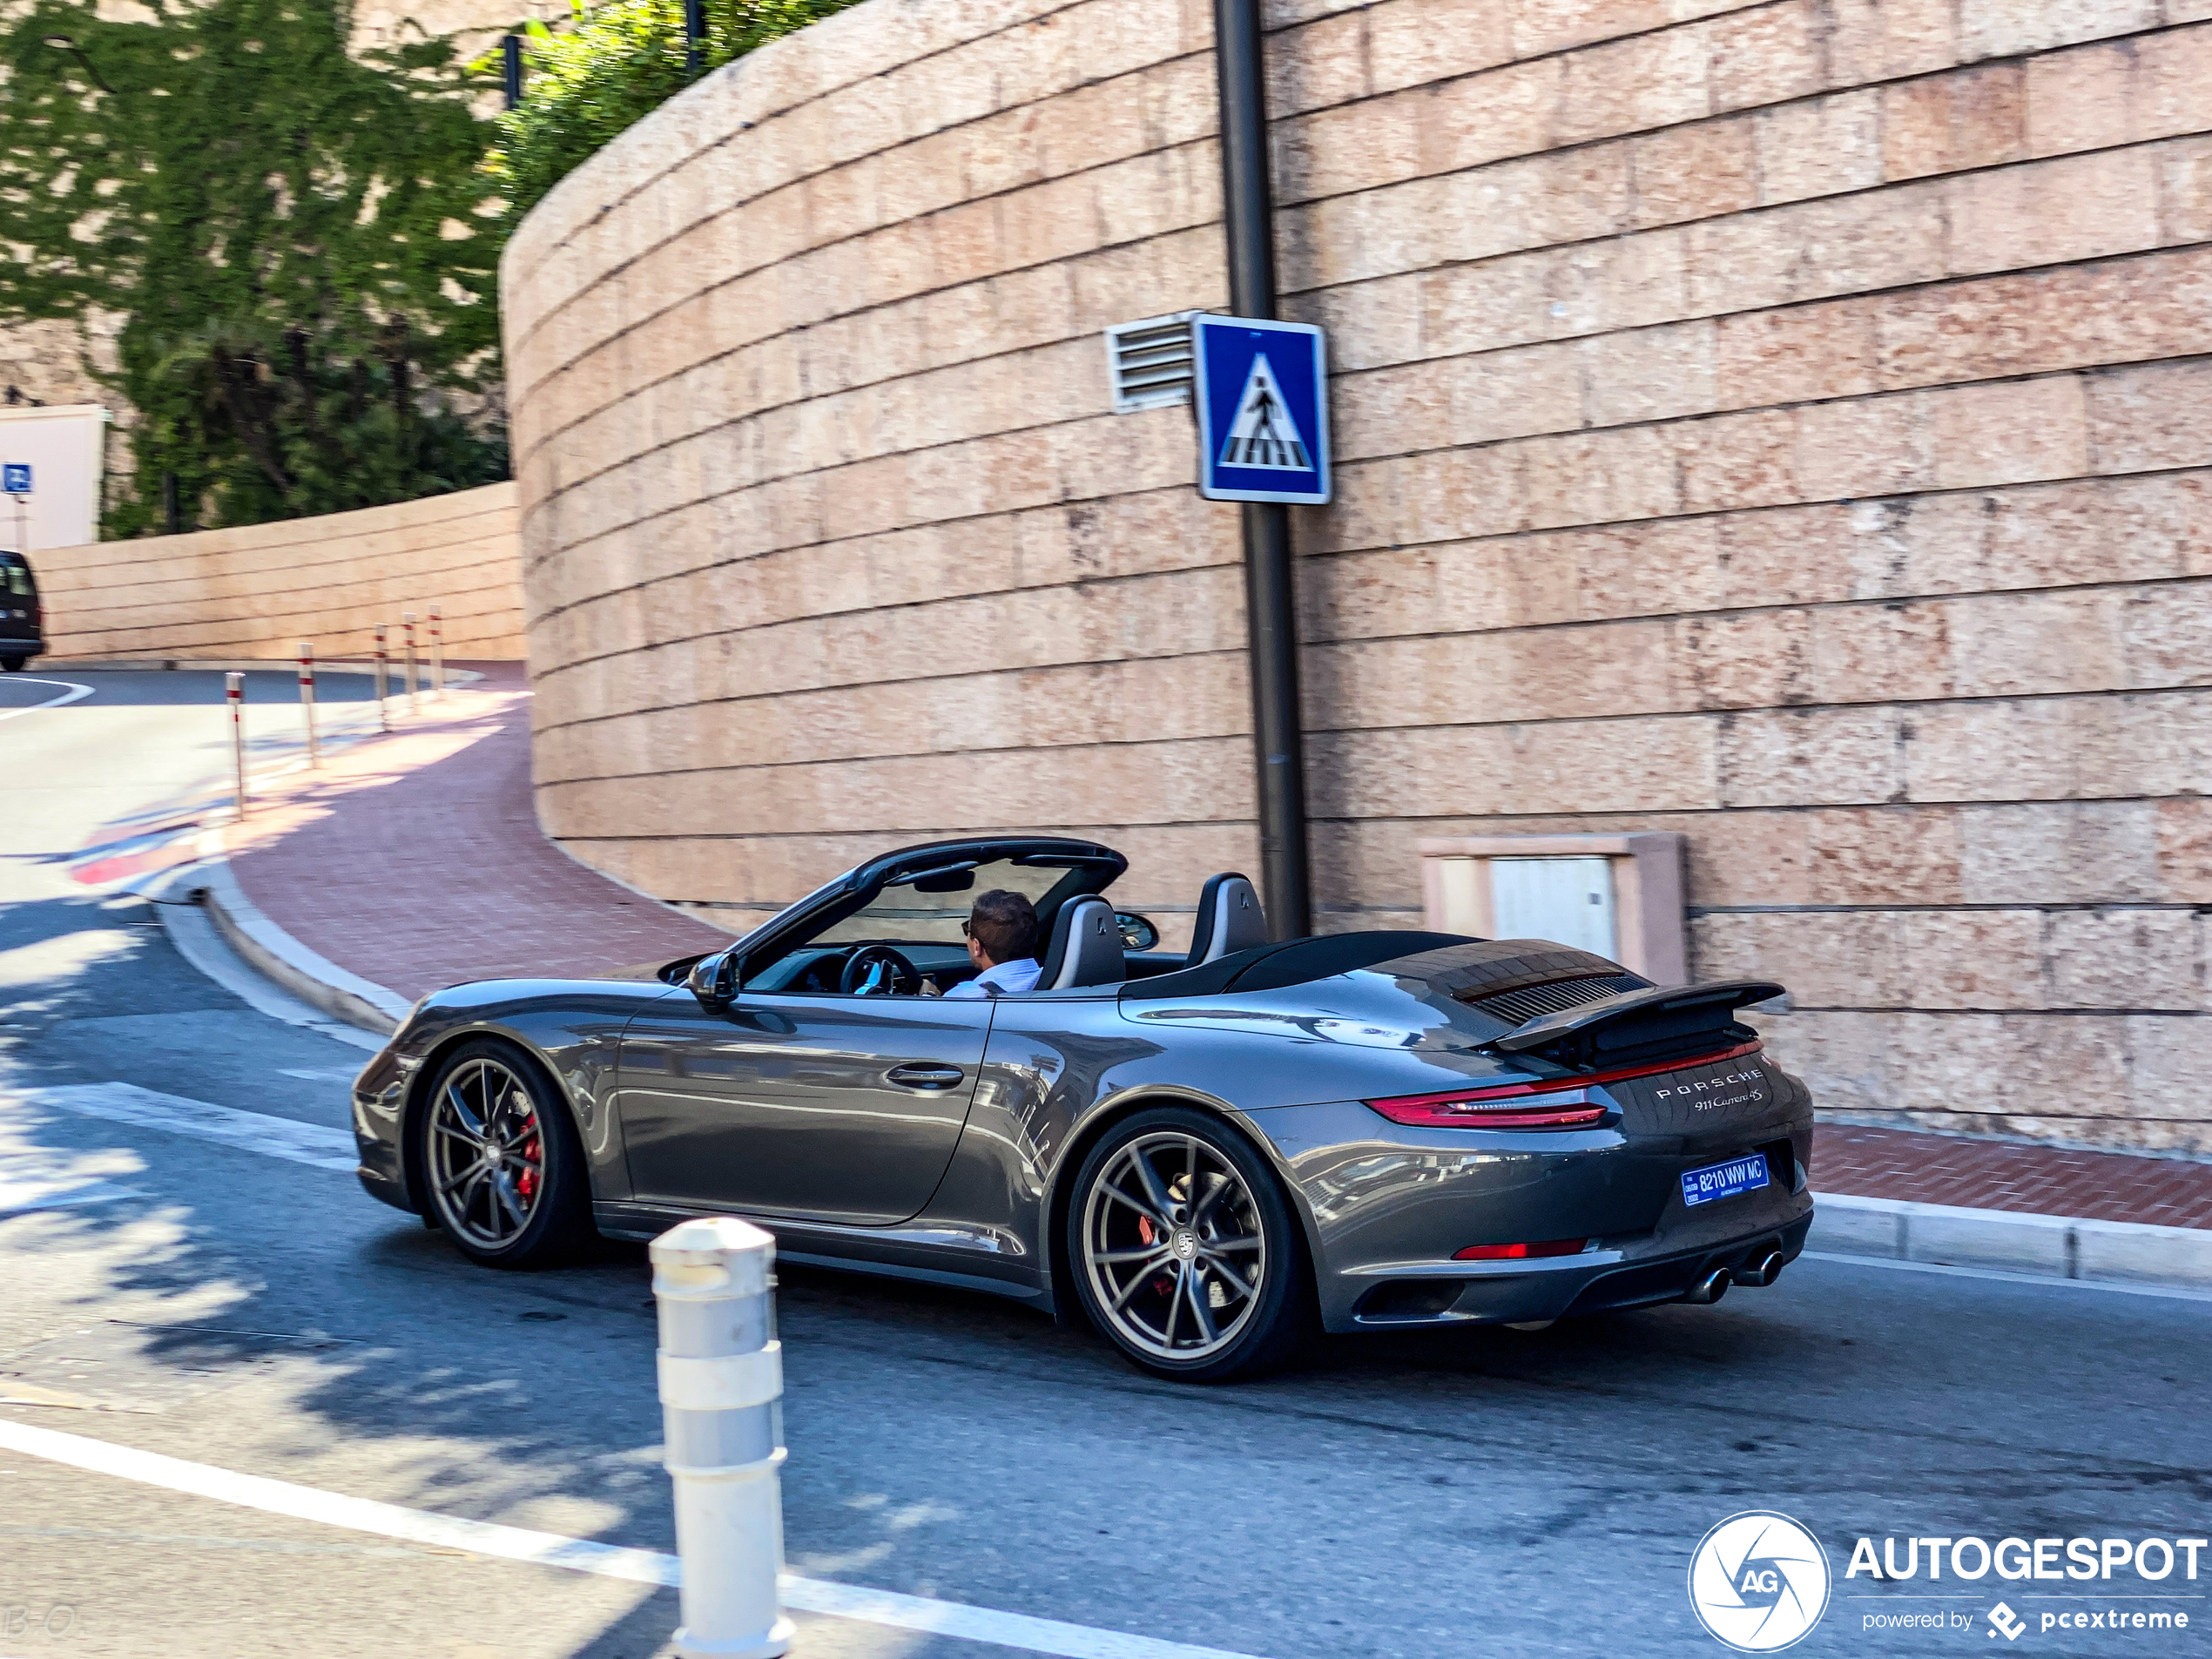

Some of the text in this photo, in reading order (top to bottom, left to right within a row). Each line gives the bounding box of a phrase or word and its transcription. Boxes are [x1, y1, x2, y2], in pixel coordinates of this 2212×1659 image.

[1656, 1069, 1764, 1099] PORSCHE
[1694, 1089, 1764, 1111] 911 Carrera 4S
[1699, 1170, 1726, 1192] 8210
[1724, 1163, 1745, 1185] WW
[1746, 1160, 1762, 1180] MC
